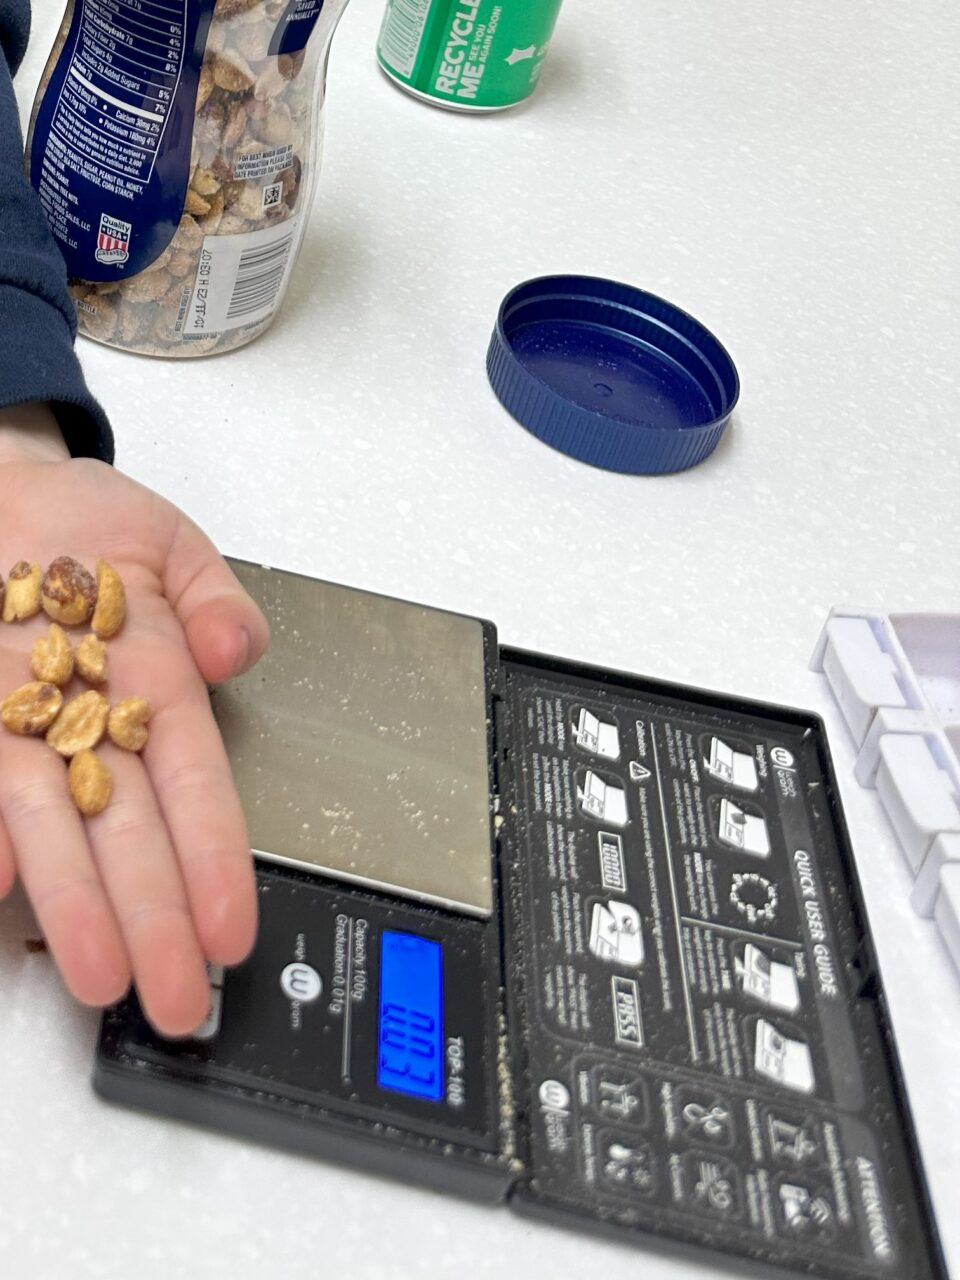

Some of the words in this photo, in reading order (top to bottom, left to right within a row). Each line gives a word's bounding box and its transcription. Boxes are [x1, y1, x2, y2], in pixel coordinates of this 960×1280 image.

[131, 0, 142, 10] 7g
[92, 14, 126, 40] Carbohydrate
[123, 34, 134, 45] 7g
[167, 49, 180, 60] 2%
[168, 37, 181, 48] 4%
[169, 24, 182, 36] 0%
[473, 23, 486, 43] YOU
[478, 33, 493, 63] AGAIN
[486, 4, 502, 34] SOON!
[90, 40, 106, 58] Sugars
[105, 52, 113, 63] 4g
[96, 31, 109, 44] Fiber
[107, 39, 117, 50] 2g
[164, 62, 178, 73] 8%
[468, 42, 480, 61] SEE
[71, 56, 87, 75] Protein
[84, 69, 93, 80] 7g
[153, 103, 166, 113] 7%
[80, 48, 98, 67] Includes
[96, 62, 105, 73] 2g
[103, 66, 121, 81] Added
[119, 74, 141, 91] Sugars
[157, 89, 171, 100] 5%
[456, 59, 485, 100] ME
[102, 118, 130, 137] Potassium
[145, 136, 157, 146] 4%
[114, 109, 136, 125] Calcium
[149, 122, 161, 133] 2%
[234, 170, 246, 178] DATE
[246, 167, 267, 177] PRINTED
[267, 165, 273, 173] ON
[273, 158, 292, 171] PACKAGE
[237, 159, 268, 169] INFORMATION
[268, 155, 284, 165] PLEASE
[248, 152, 262, 160] BEST
[262, 149, 275, 158] WHEN
[54, 170, 71, 187] PEANUT.
[65, 148, 85, 166] PEANUTS,
[82, 160, 100, 175] SUGAR,
[98, 169, 117, 183] PEANUT
[115, 176, 127, 188] OIL,
[125, 181, 145, 195] HONEY,
[69, 160, 82, 174] SALT,
[78, 167, 104, 186] FRUCTOSE,
[100, 179, 115, 191] CORN
[112, 185, 136, 201] STARCH,
[58, 185, 69, 197] TREE
[50, 199, 66, 215] FOODS
[64, 210, 82, 226] SALES,
[79, 220, 91, 231] LLC
[52, 210, 68, 225] PLACE
[102, 215, 130, 232] Quality
[67, 238, 79, 248] LLC
[106, 227, 122, 239] USA
[198, 248, 213, 277] 03:07
[197, 277, 209, 287] H
[193, 286, 208, 329] 10/11/23
[556, 721, 565, 740] MODE
[635, 719, 647, 757] Calibration
[543, 781, 552, 803] MODE
[775, 769, 789, 796] gram
[692, 851, 703, 873] MODE
[753, 742, 769, 778] Weighing
[792, 949, 808, 979] Taring
[793, 848, 819, 898] QUICK
[802, 898, 827, 943] USER
[295, 932, 304, 961] weigh
[601, 842, 621, 886] 10000
[615, 990, 637, 1039] PASS
[810, 942, 838, 997] GUIDE
[352, 967, 366, 1001] 100g
[289, 999, 302, 1029] gram
[446, 1034, 465, 1106] TOP-100
[853, 1155, 893, 1258] ATTENTION
